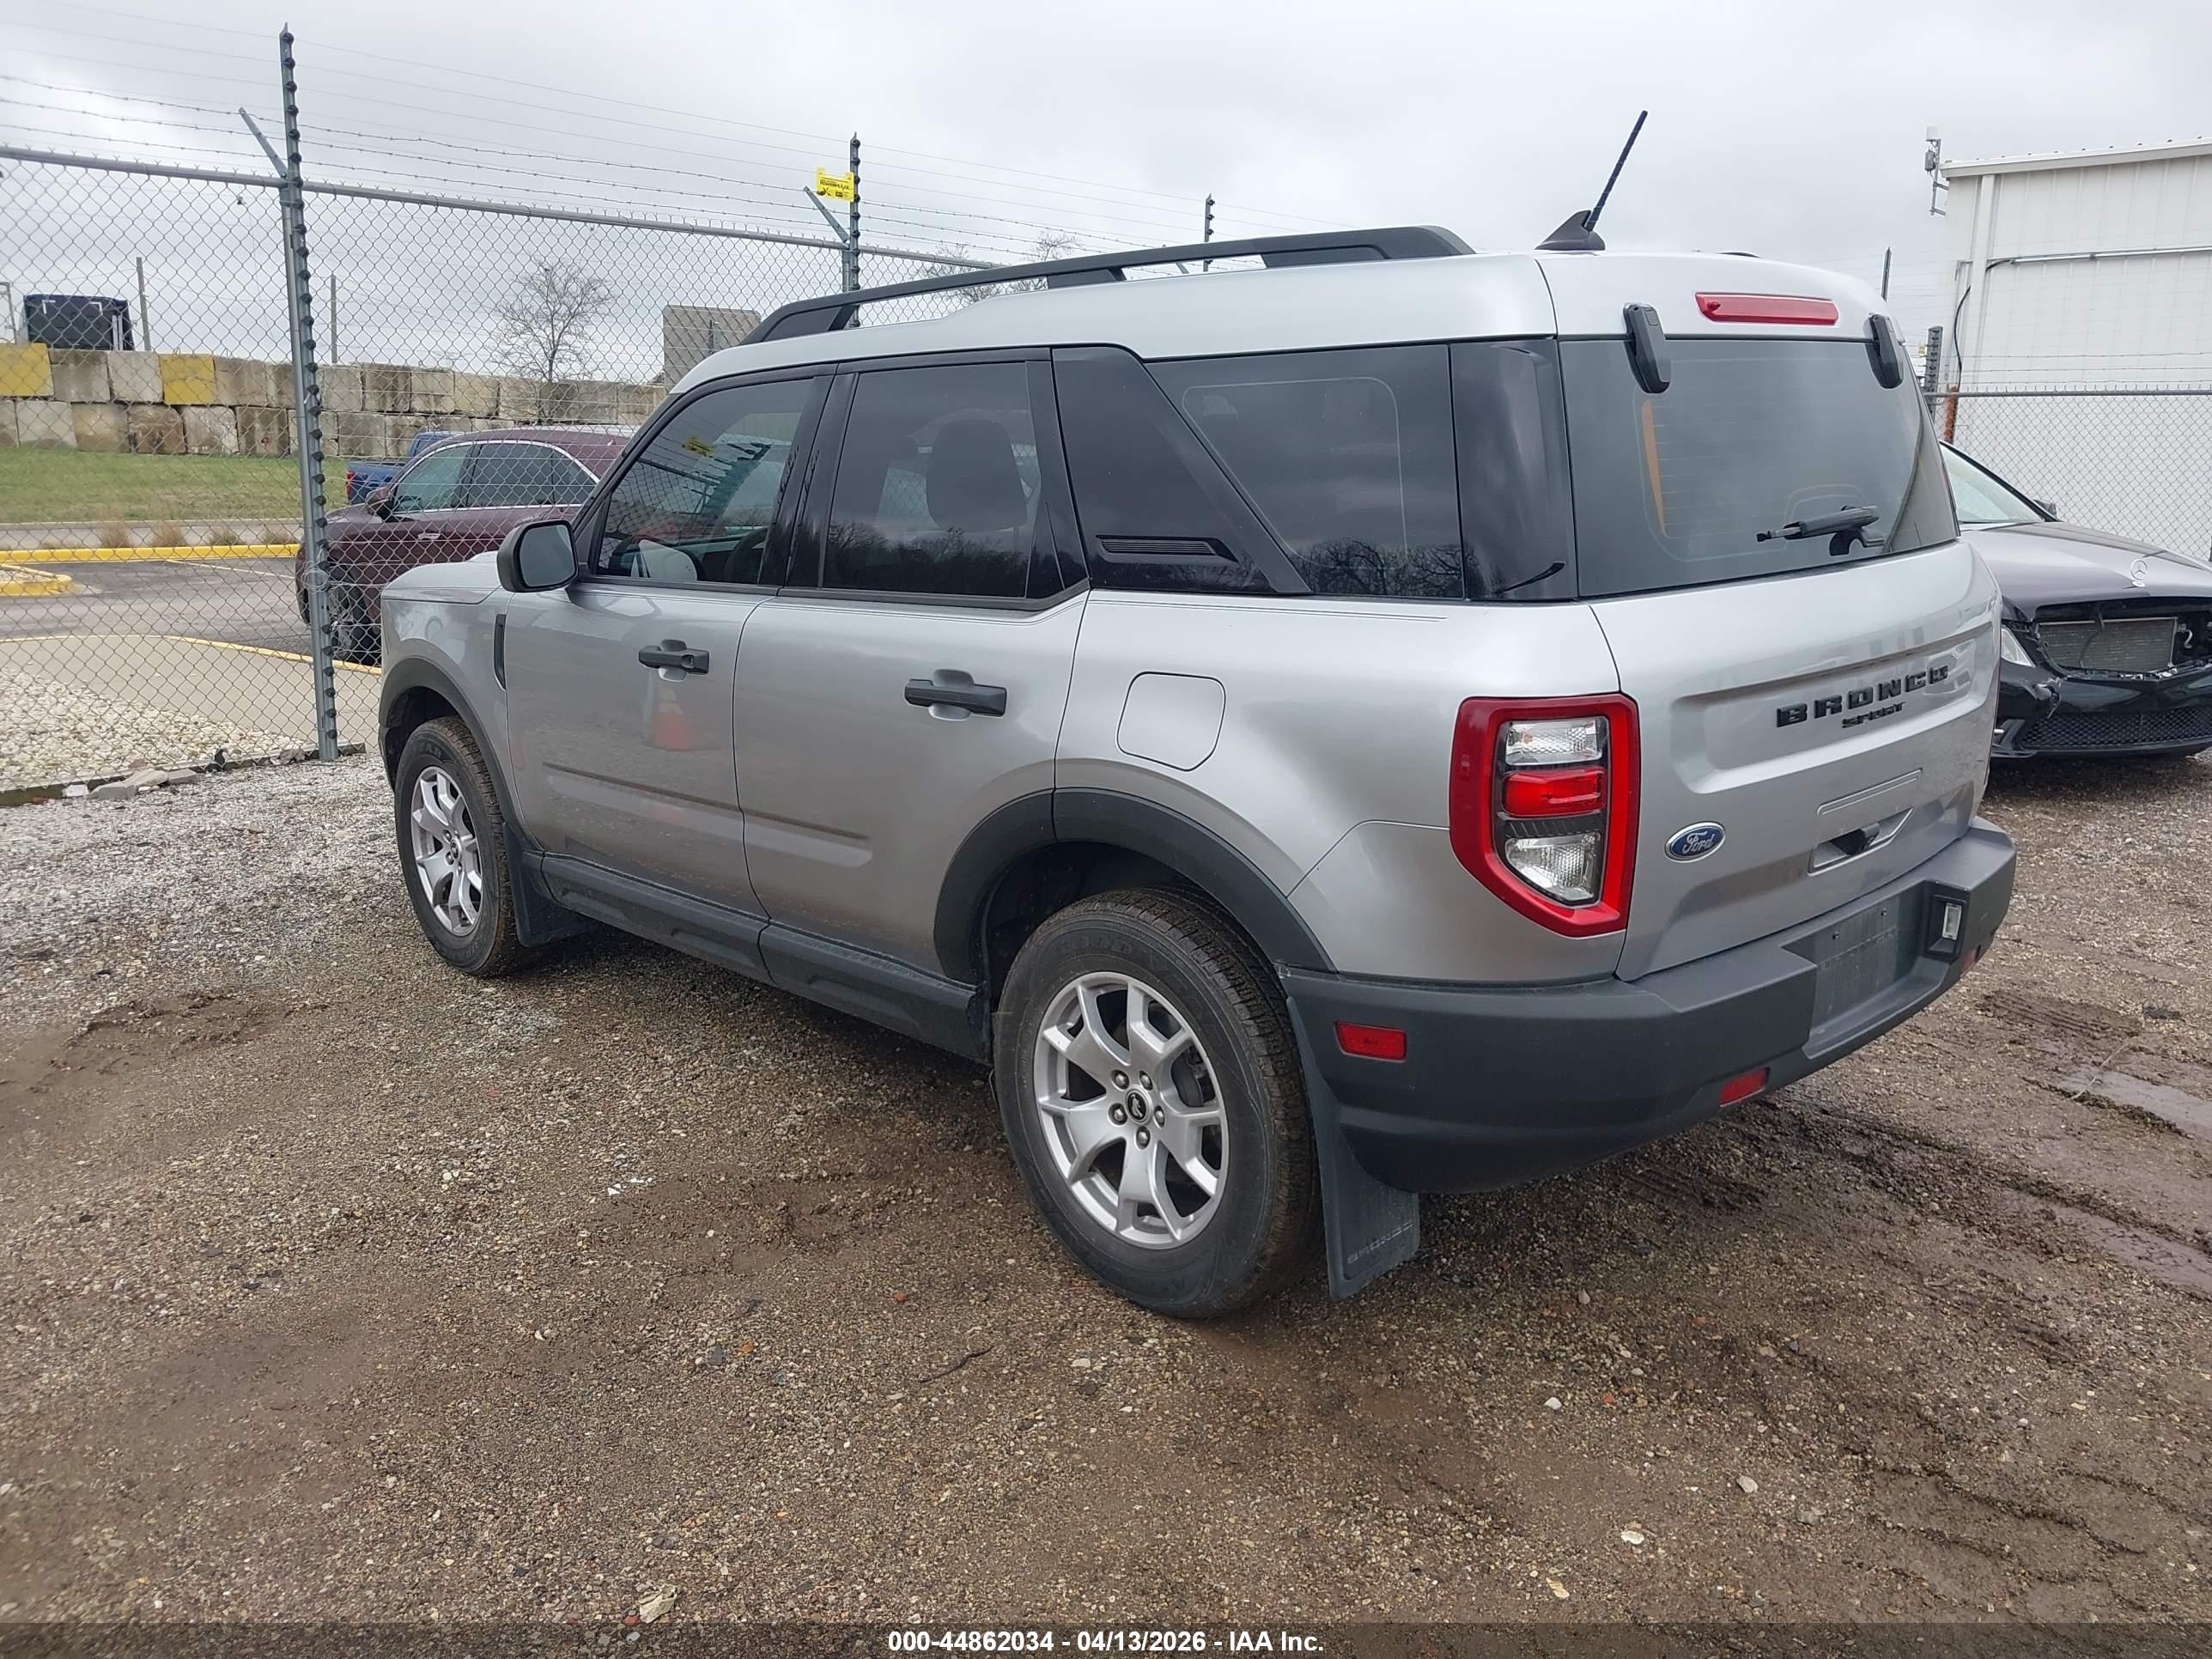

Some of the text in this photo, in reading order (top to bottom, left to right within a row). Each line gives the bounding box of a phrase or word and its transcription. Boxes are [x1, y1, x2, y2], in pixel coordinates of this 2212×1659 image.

[1776, 664, 1948, 727] BRONCO
[1841, 701, 1906, 728] SPORT
[1682, 830, 1716, 854] Ford
